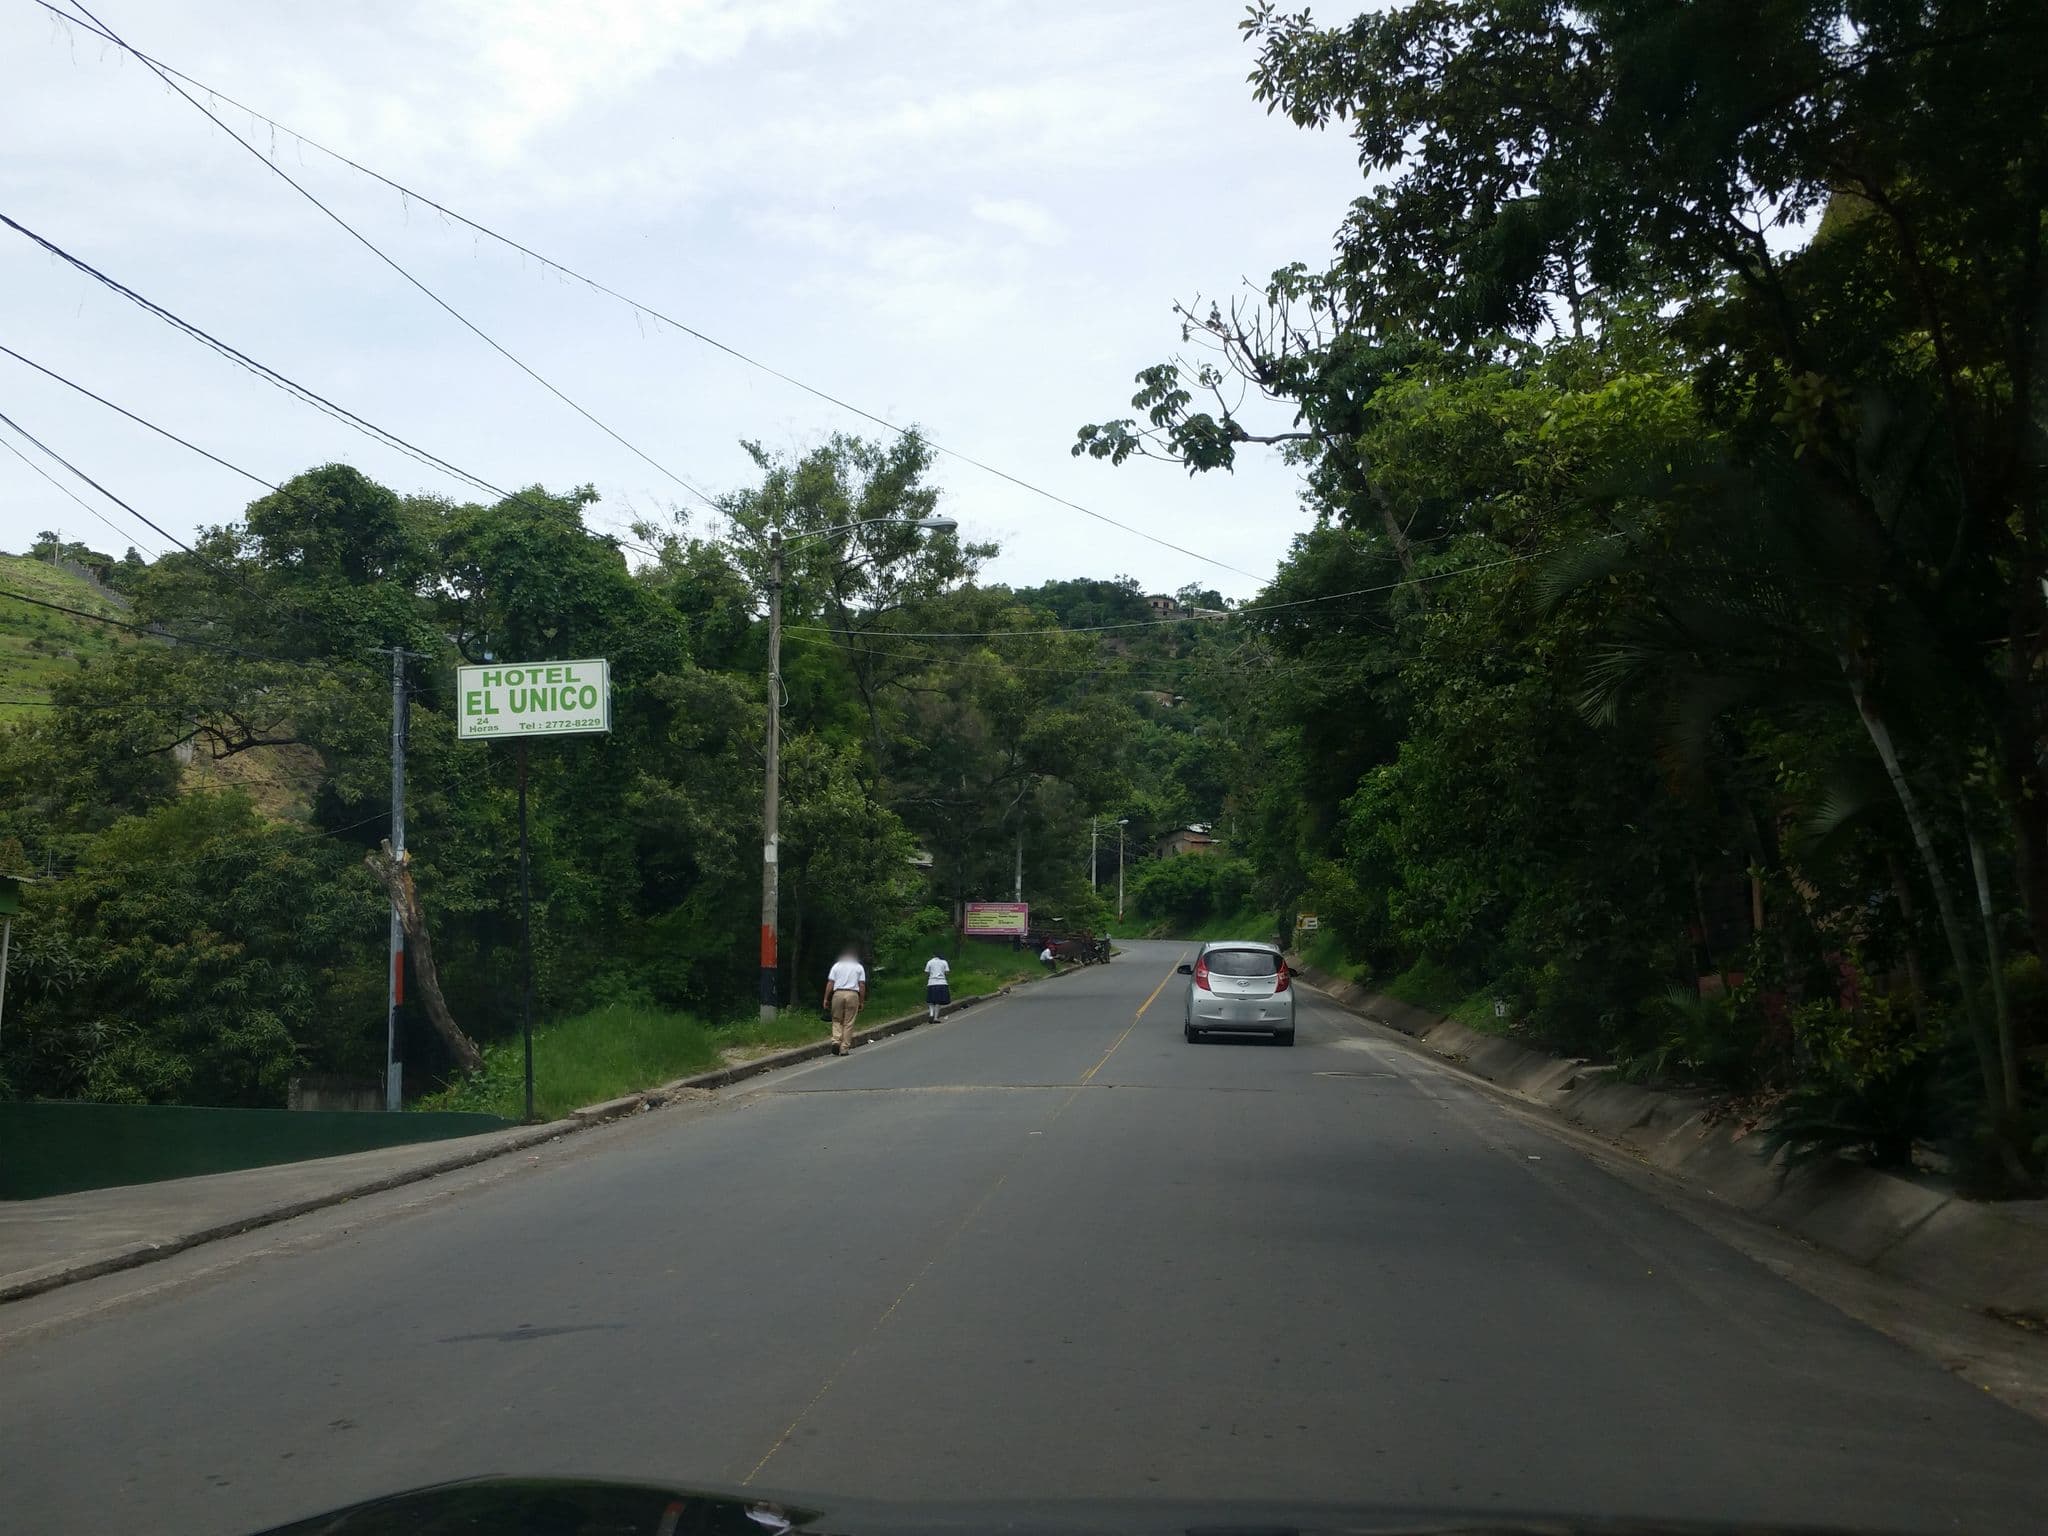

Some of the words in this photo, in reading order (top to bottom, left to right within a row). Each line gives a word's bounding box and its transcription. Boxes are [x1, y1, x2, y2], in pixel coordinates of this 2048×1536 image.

[482, 667, 581, 687] HOTEL
[466, 690, 500, 716] EL
[509, 685, 598, 714] UNICO
[476, 717, 489, 725] 24
[469, 725, 499, 733] Horas
[518, 722, 536, 730] Tel
